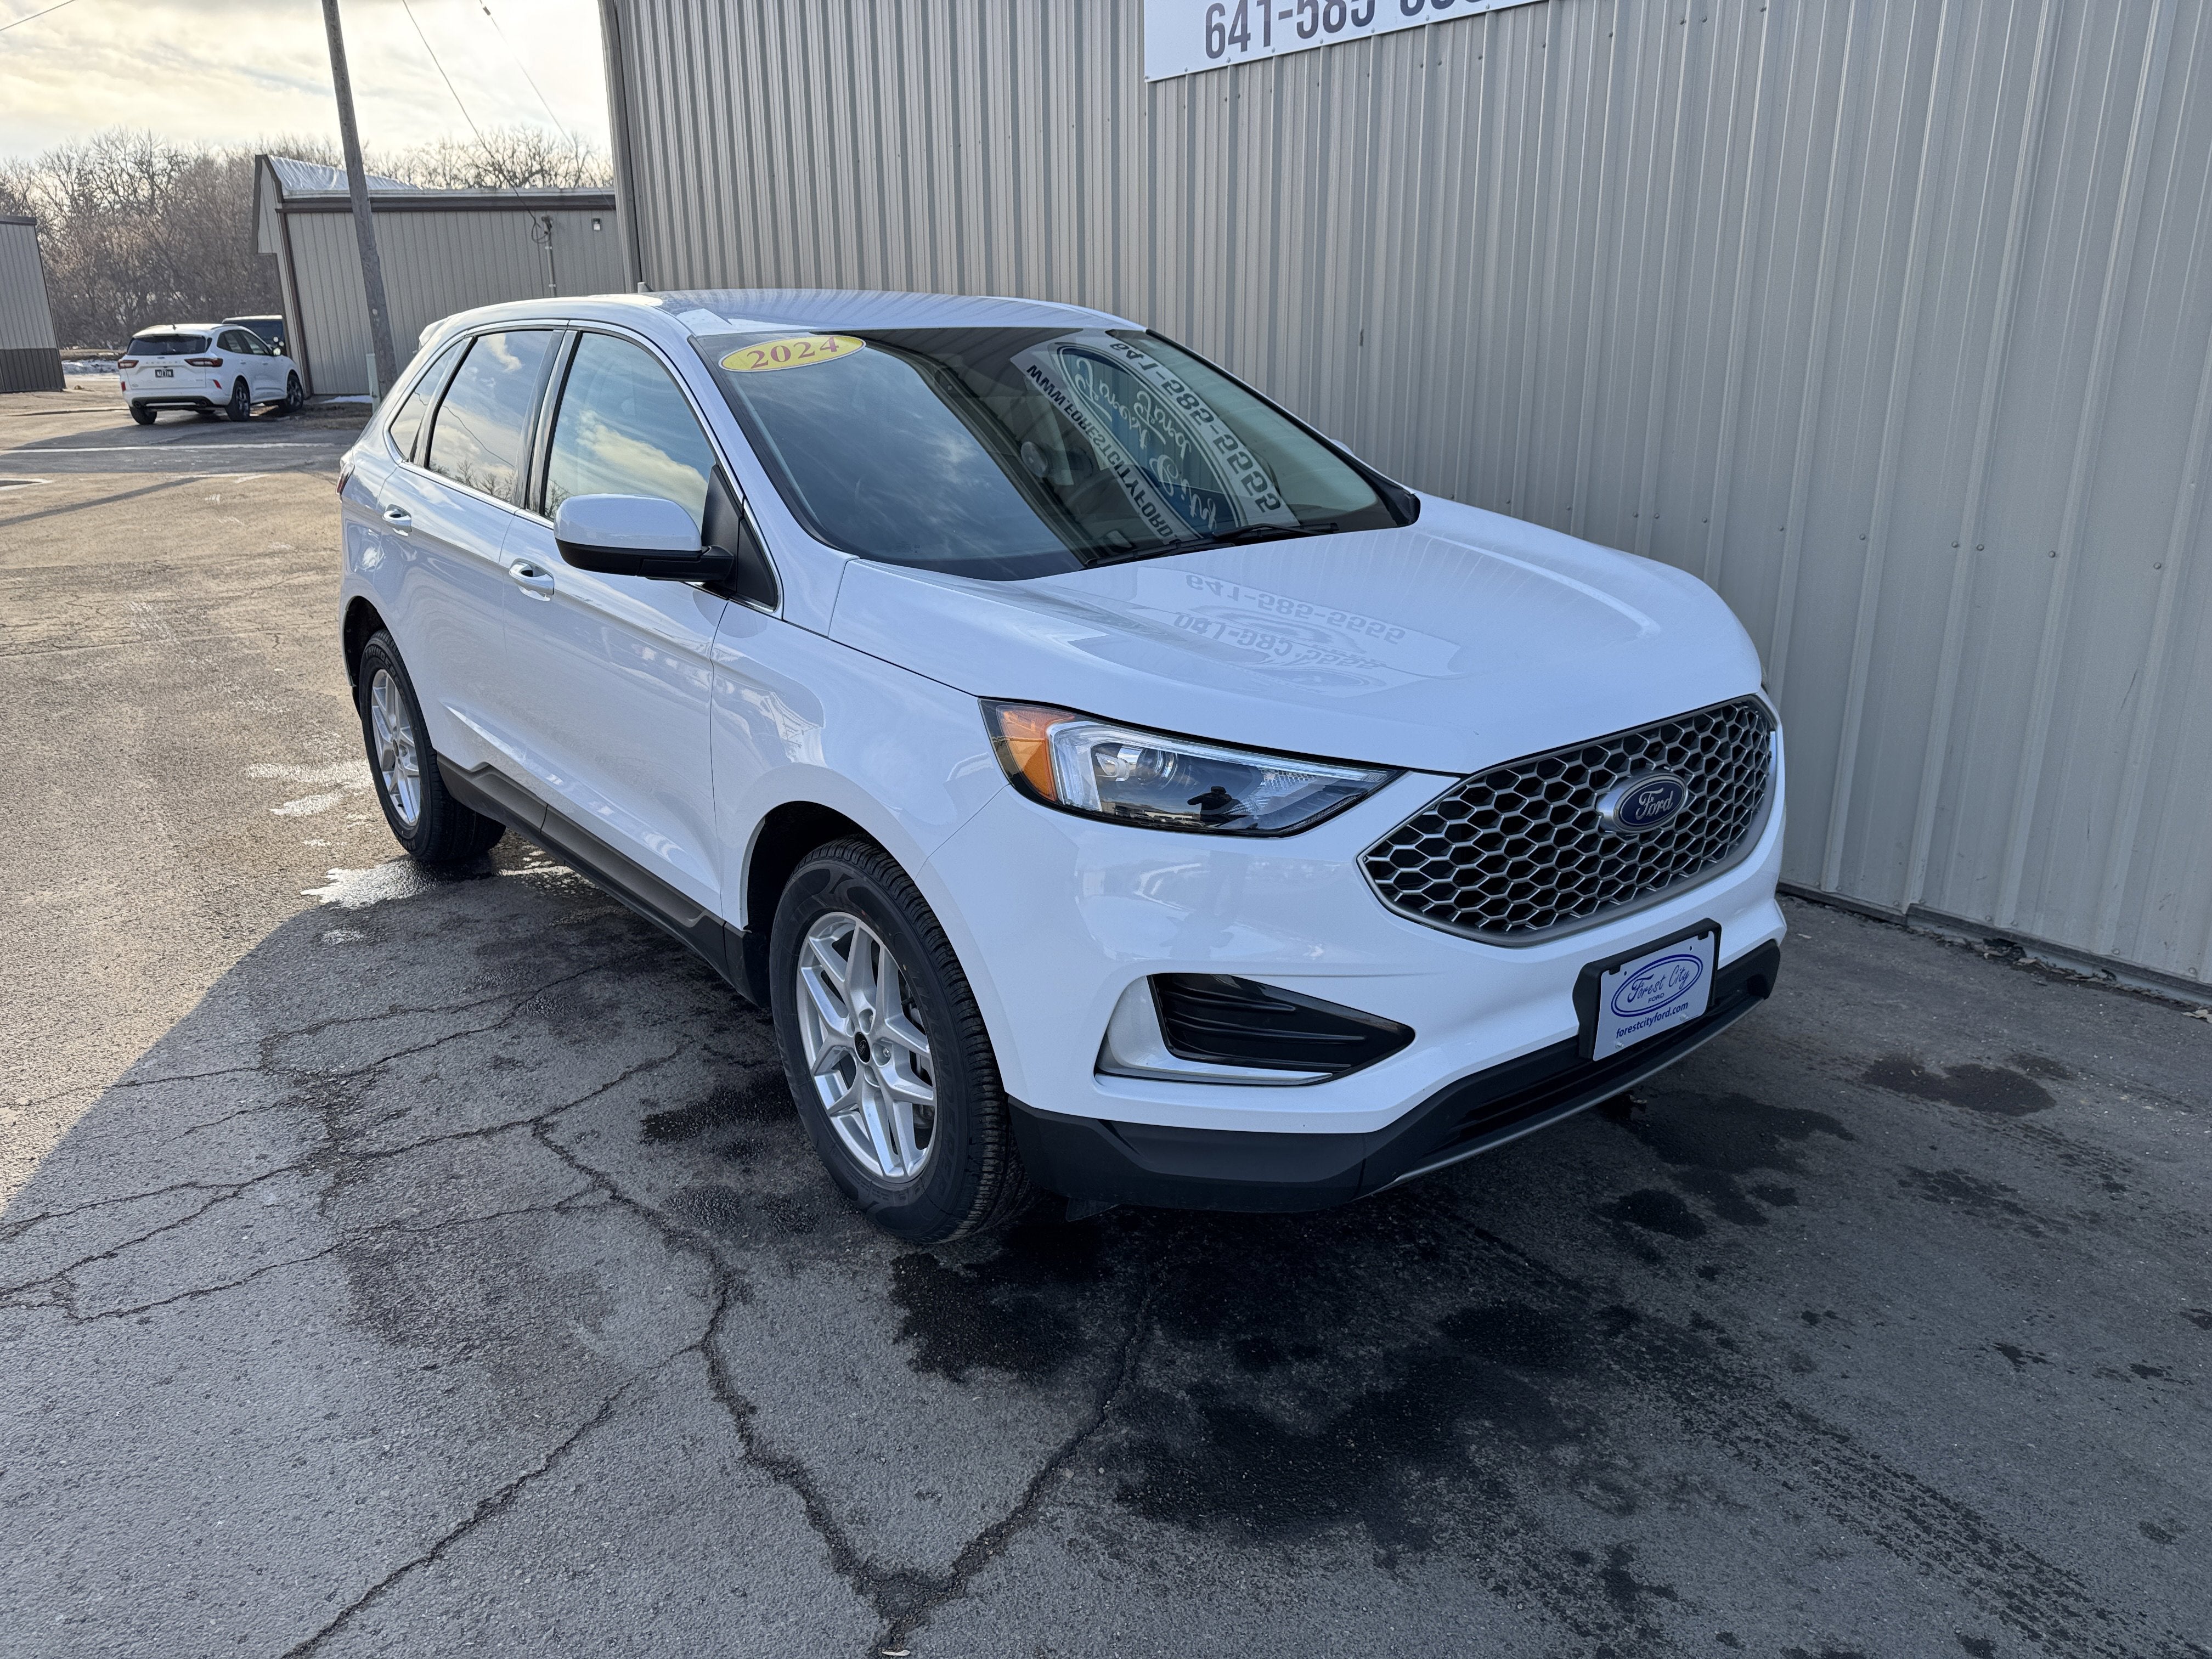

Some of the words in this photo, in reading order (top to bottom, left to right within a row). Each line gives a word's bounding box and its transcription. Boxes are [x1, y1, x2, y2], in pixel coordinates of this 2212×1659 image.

[1205, 0, 1480, 59] 641-58
[746, 336, 839, 369] 2024
[1635, 787, 1674, 820] Ford
[1627, 974, 1666, 1003] Forest
[1668, 964, 1690, 990] City
[1647, 992, 1664, 1003] FORD
[1616, 1002, 1689, 1039] forestcityford.com
